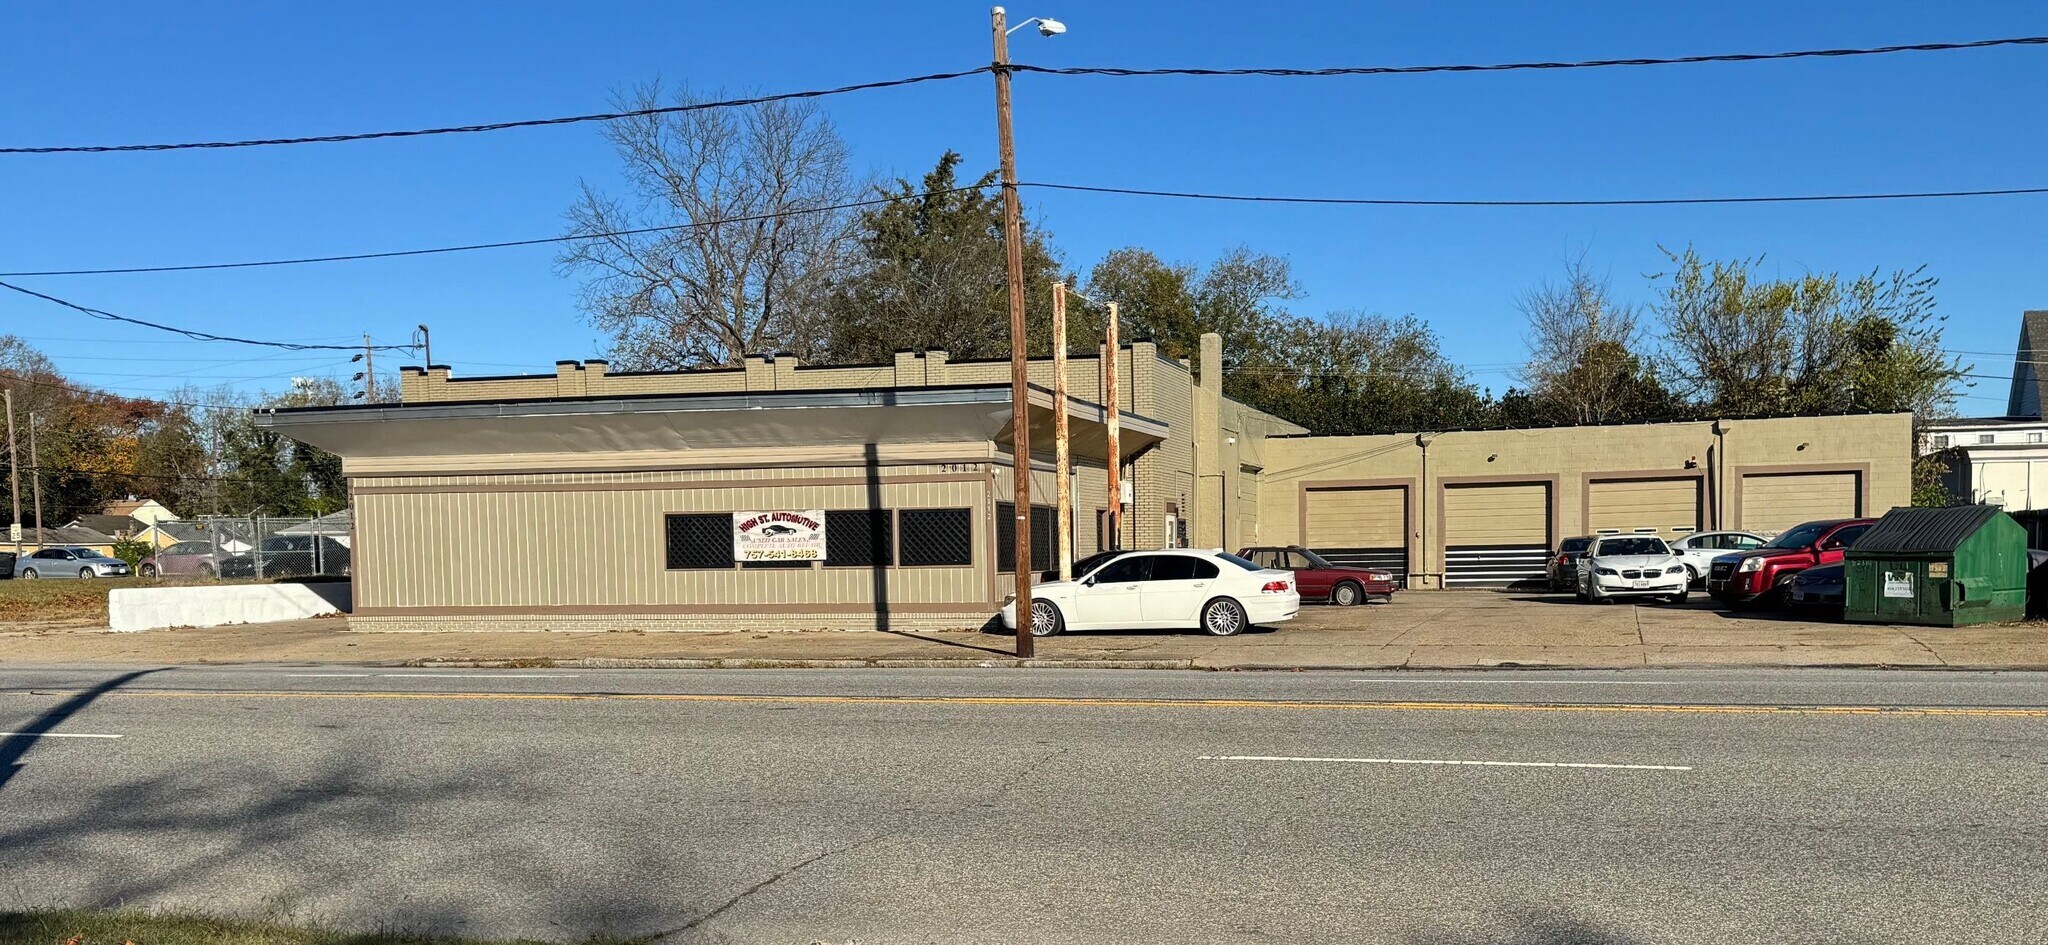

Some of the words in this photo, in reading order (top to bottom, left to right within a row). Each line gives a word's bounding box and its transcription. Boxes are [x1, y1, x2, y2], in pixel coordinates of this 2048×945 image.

[941, 463, 978, 472] 2012
[738, 517, 759, 533] HIGH
[758, 514, 770, 525] ST.
[771, 512, 820, 532] AUTOMOTIVE
